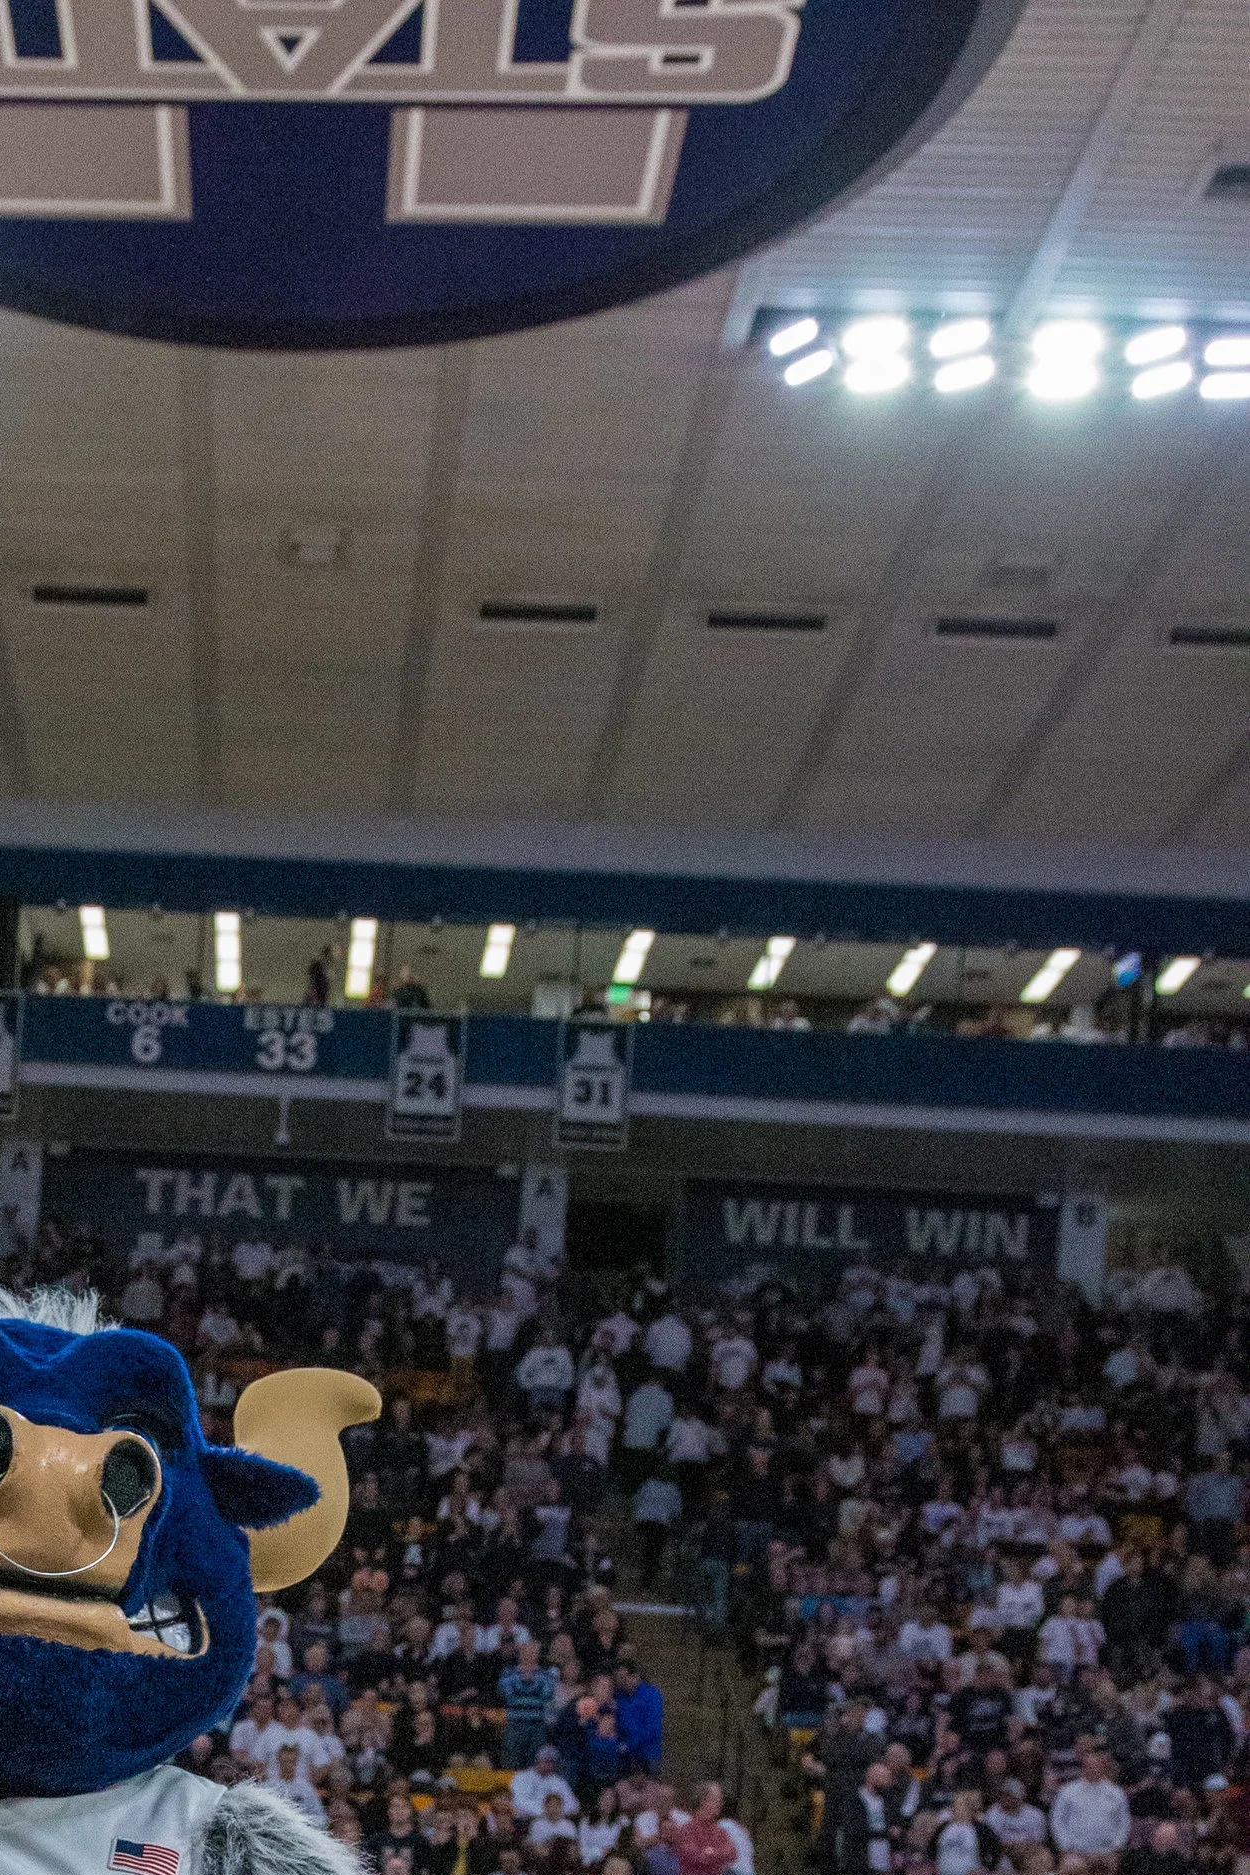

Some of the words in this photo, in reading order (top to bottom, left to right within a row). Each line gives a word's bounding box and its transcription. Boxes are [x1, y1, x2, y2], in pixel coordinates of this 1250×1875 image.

[106, 1000, 190, 1027] COOK
[244, 1005, 335, 1034] ESTES
[131, 1024, 162, 1063] 6
[257, 1029, 317, 1071] 33
[404, 1070, 447, 1099] 24
[572, 1076, 613, 1107] 31
[135, 1167, 306, 1221] THAT
[336, 1179, 437, 1228] WE
[722, 1196, 869, 1251] WILL
[905, 1207, 1031, 1260] WIN
